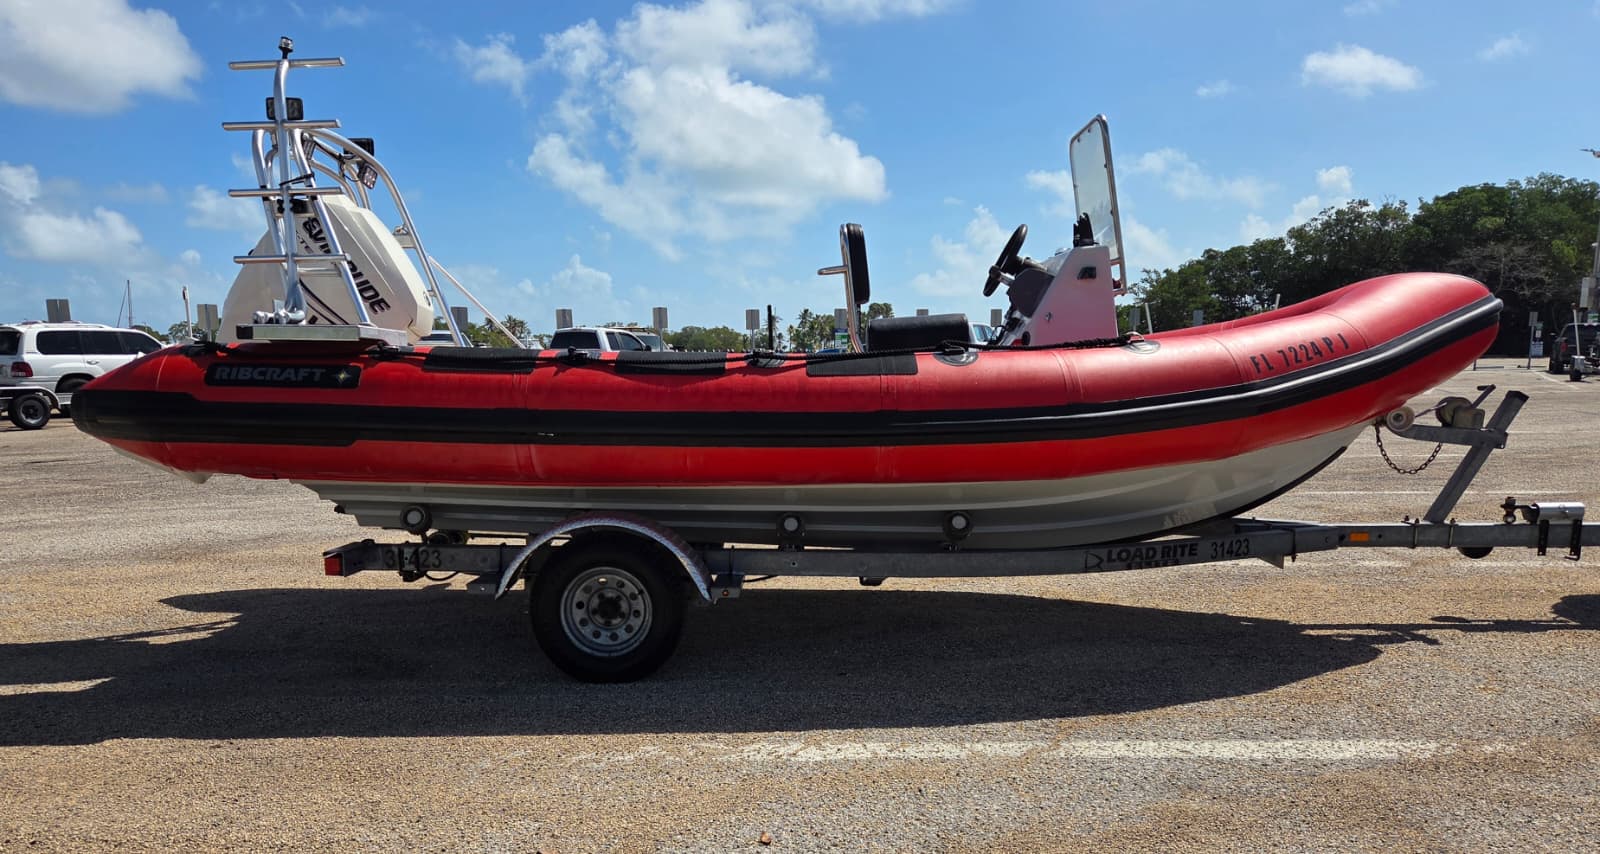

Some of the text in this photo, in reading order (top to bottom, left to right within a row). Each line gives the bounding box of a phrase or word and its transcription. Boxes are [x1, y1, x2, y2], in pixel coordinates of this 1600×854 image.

[214, 366, 326, 381] RIBCRAFT
[1249, 354, 1274, 374] FL
[1106, 546, 1156, 563] LOAD
[1160, 543, 1198, 559] RITE
[1210, 538, 1250, 559] 31423
[385, 549, 442, 569] 3423
